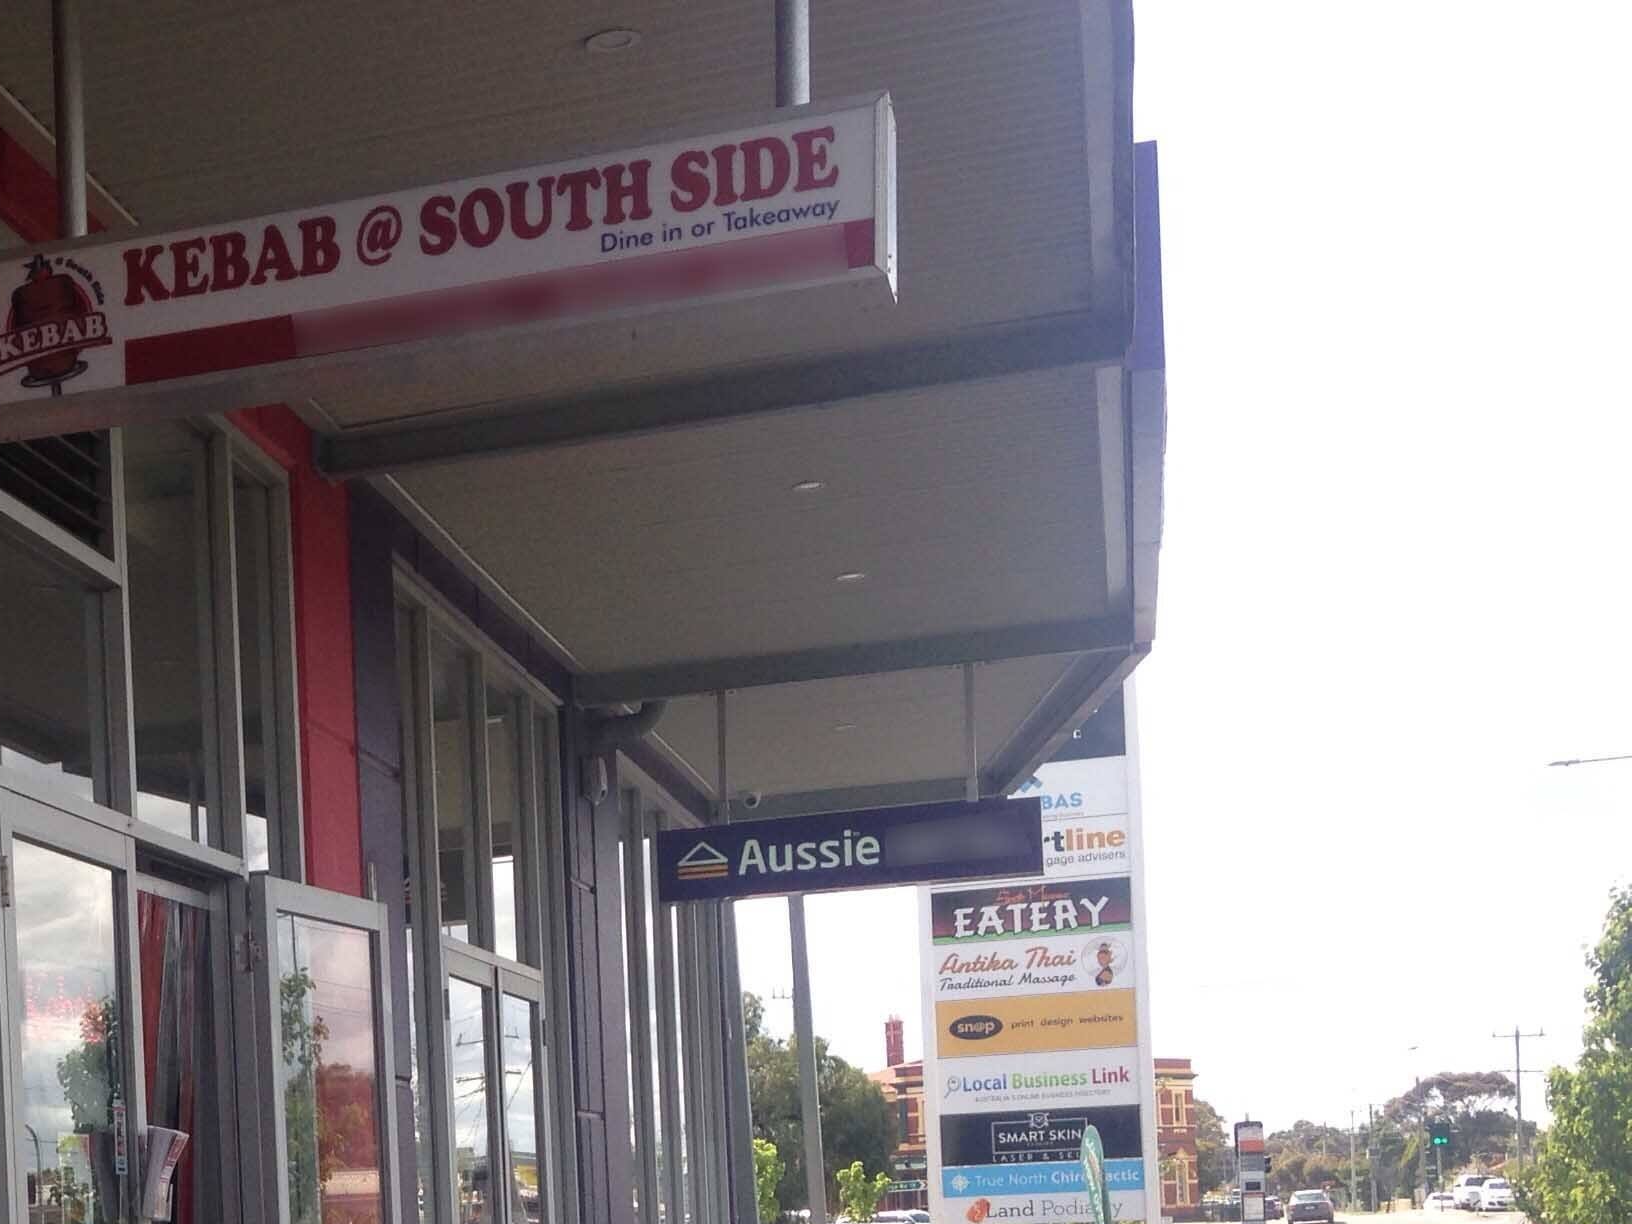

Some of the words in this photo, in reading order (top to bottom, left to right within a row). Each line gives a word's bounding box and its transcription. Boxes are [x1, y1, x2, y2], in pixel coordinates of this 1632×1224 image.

[123, 216, 341, 306] KEBAB
[357, 205, 403, 266] @
[419, 158, 652, 256] SOUTH
[669, 126, 839, 213] SIDE
[600, 230, 655, 254] Dine
[662, 223, 683, 242] in
[691, 219, 715, 238] or
[722, 199, 840, 233] Takeaway
[1041, 792, 1083, 810] BAS
[738, 828, 881, 876] Aussie
[954, 895, 1109, 938] EATERY
[939, 951, 1018, 975] Antika
[1025, 946, 1077, 969] Thai
[939, 975, 1015, 991] Traditional
[1017, 973, 1076, 986] Massage
[1011, 1019, 1034, 1030] print
[1040, 1017, 1073, 1028] design
[1079, 1014, 1124, 1024] websites
[962, 1073, 1008, 1092] Local
[1011, 1072, 1087, 1090] Business
[1092, 1065, 1129, 1085] Link
[998, 1130, 1045, 1144] SMART
[1049, 1128, 1082, 1141] SKIN
[992, 1152, 1033, 1163] LASER
[1042, 1152, 1050, 1160] &
[975, 1174, 1005, 1187] True
[1008, 1172, 1048, 1186] North
[1051, 1168, 1140, 1185] Chiractic
[986, 1199, 1034, 1219] Land
